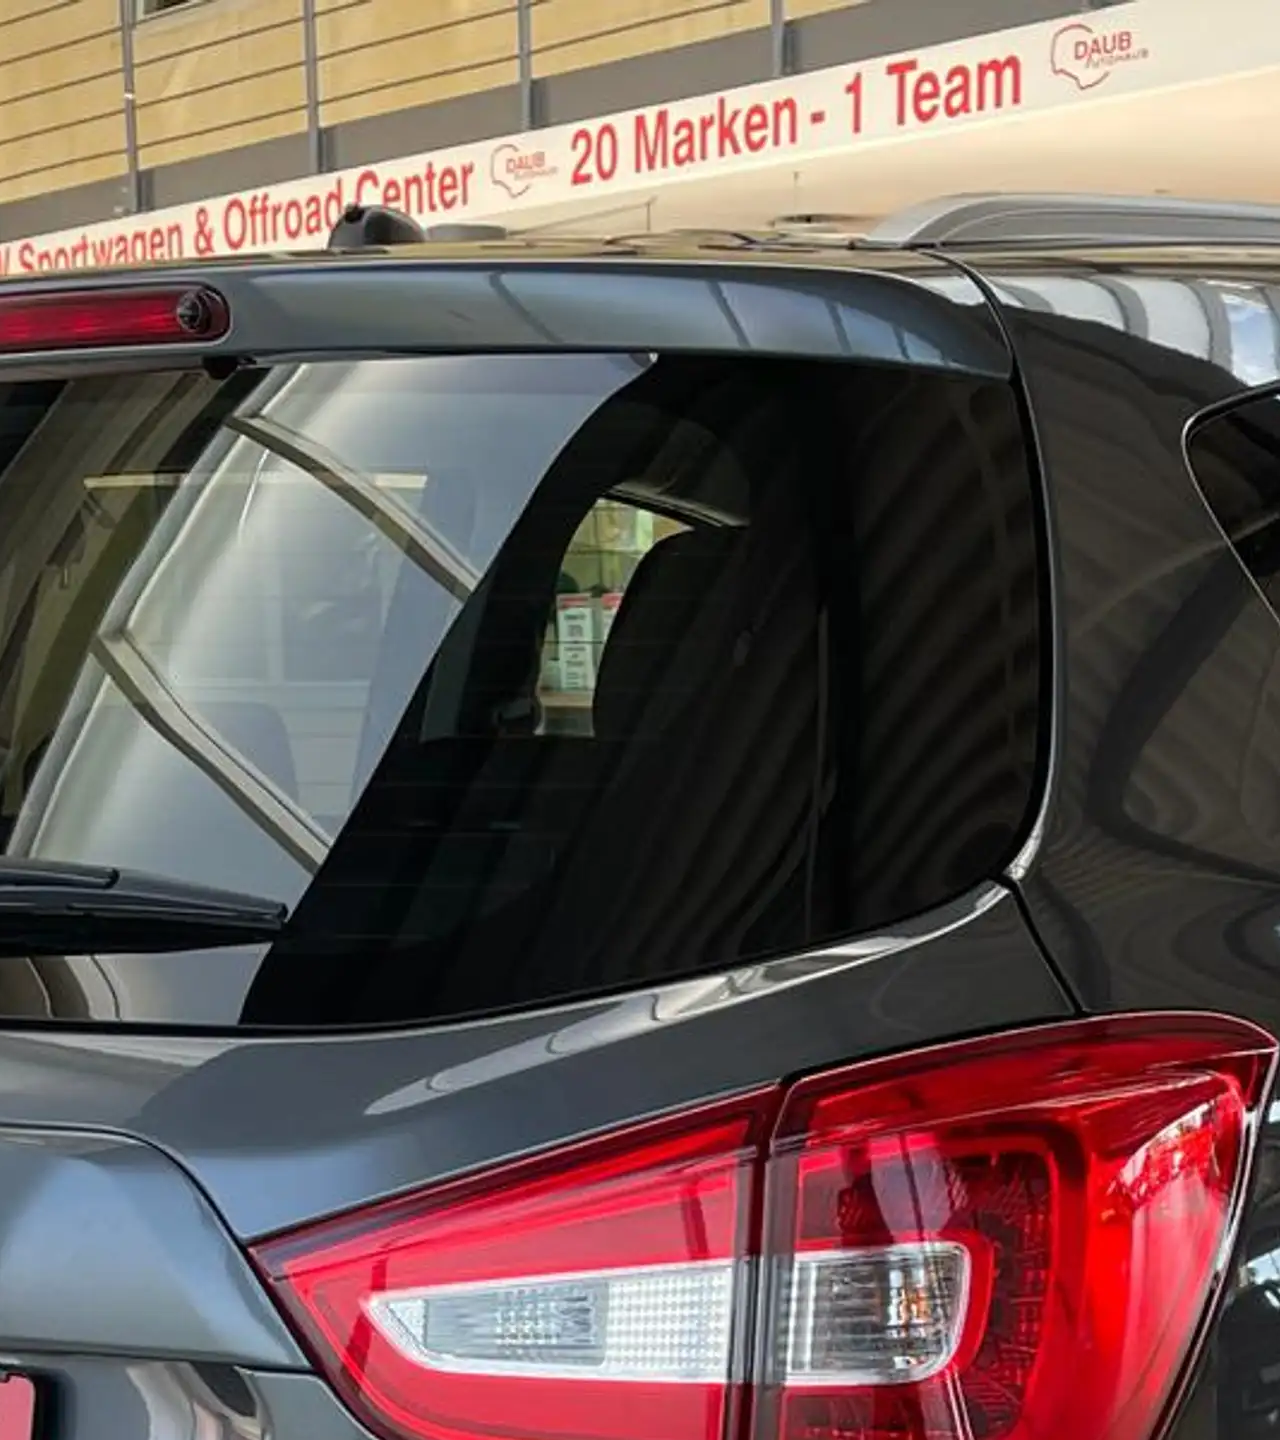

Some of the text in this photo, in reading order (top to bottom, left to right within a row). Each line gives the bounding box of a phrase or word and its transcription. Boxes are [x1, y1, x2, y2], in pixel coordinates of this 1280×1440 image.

[1074, 31, 1131, 64] DAUB
[570, 123, 618, 186] 20
[632, 97, 797, 173] Marken
[845, 71, 863, 134] 1
[886, 54, 1022, 125] Team
[194, 206, 214, 257] &
[223, 176, 342, 250] Offroad
[355, 160, 475, 213] Center
